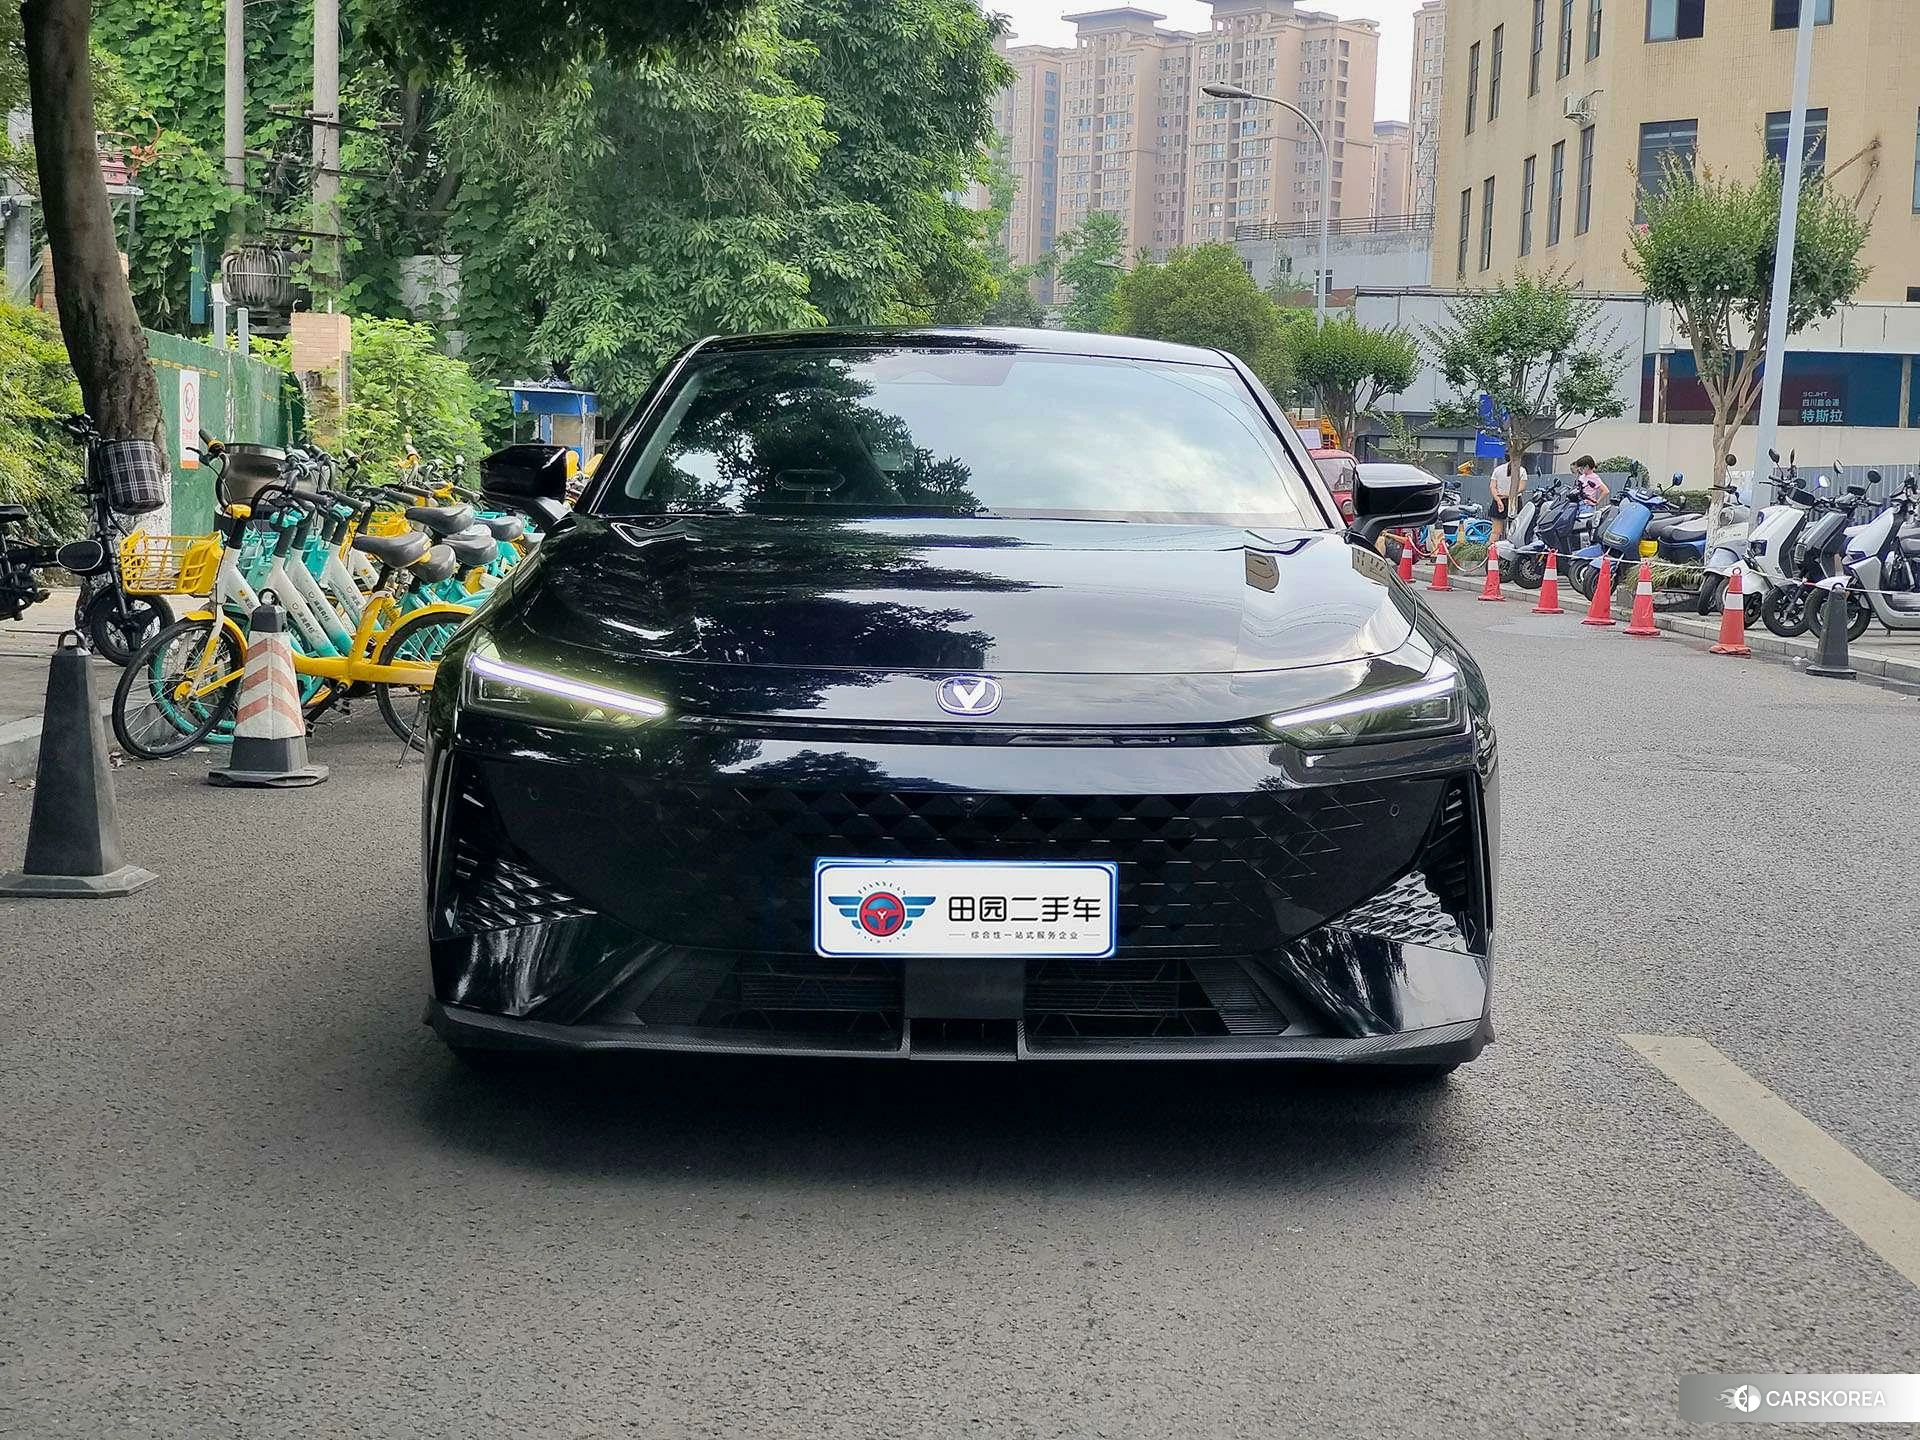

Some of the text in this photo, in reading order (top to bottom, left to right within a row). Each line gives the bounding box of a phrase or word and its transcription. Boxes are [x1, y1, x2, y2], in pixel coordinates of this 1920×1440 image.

[1801, 409, 1843, 423] 特斯拉
[948, 896, 1101, 922] 田园二手车
[971, 931, 1078, 940] 综合性一站式服务企业
